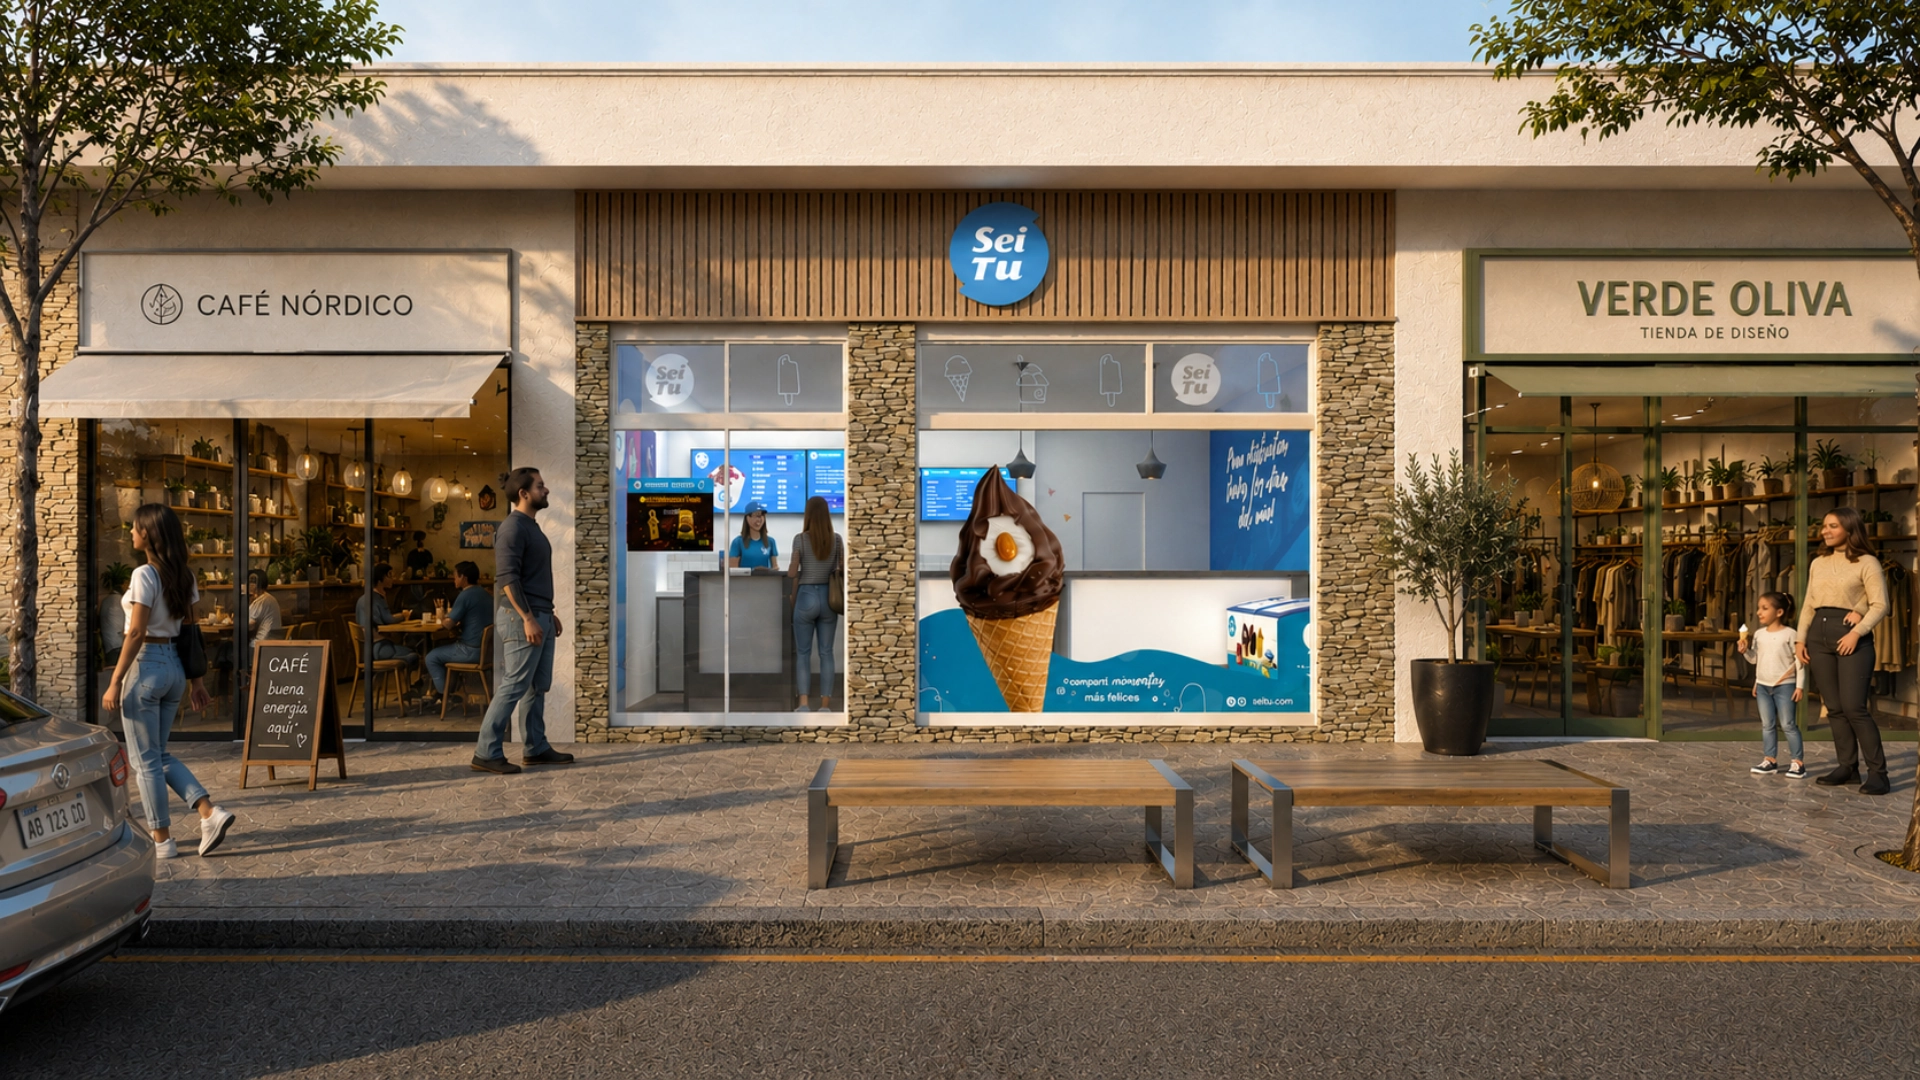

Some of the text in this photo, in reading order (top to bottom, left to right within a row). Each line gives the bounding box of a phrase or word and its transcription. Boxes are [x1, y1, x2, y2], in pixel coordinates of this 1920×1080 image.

[972, 226, 1028, 253] Sei
[971, 257, 1023, 281] Tu
[197, 289, 413, 316] CAFÉ NÓRDICO
[1577, 280, 1853, 316] VERDE OLIVA
[1640, 324, 1790, 339] TIENDA DE DISEÑO
[656, 364, 687, 380] Sei
[1182, 364, 1212, 380] Sei
[656, 381, 681, 395] Tu
[1182, 381, 1208, 395] Tu
[268, 652, 309, 673] CAFÉ
[267, 680, 305, 695] buena
[1084, 691, 1140, 702] más felices
[27, 818, 44, 839] AB
[46, 808, 68, 832] 123
[70, 802, 86, 824] CO
